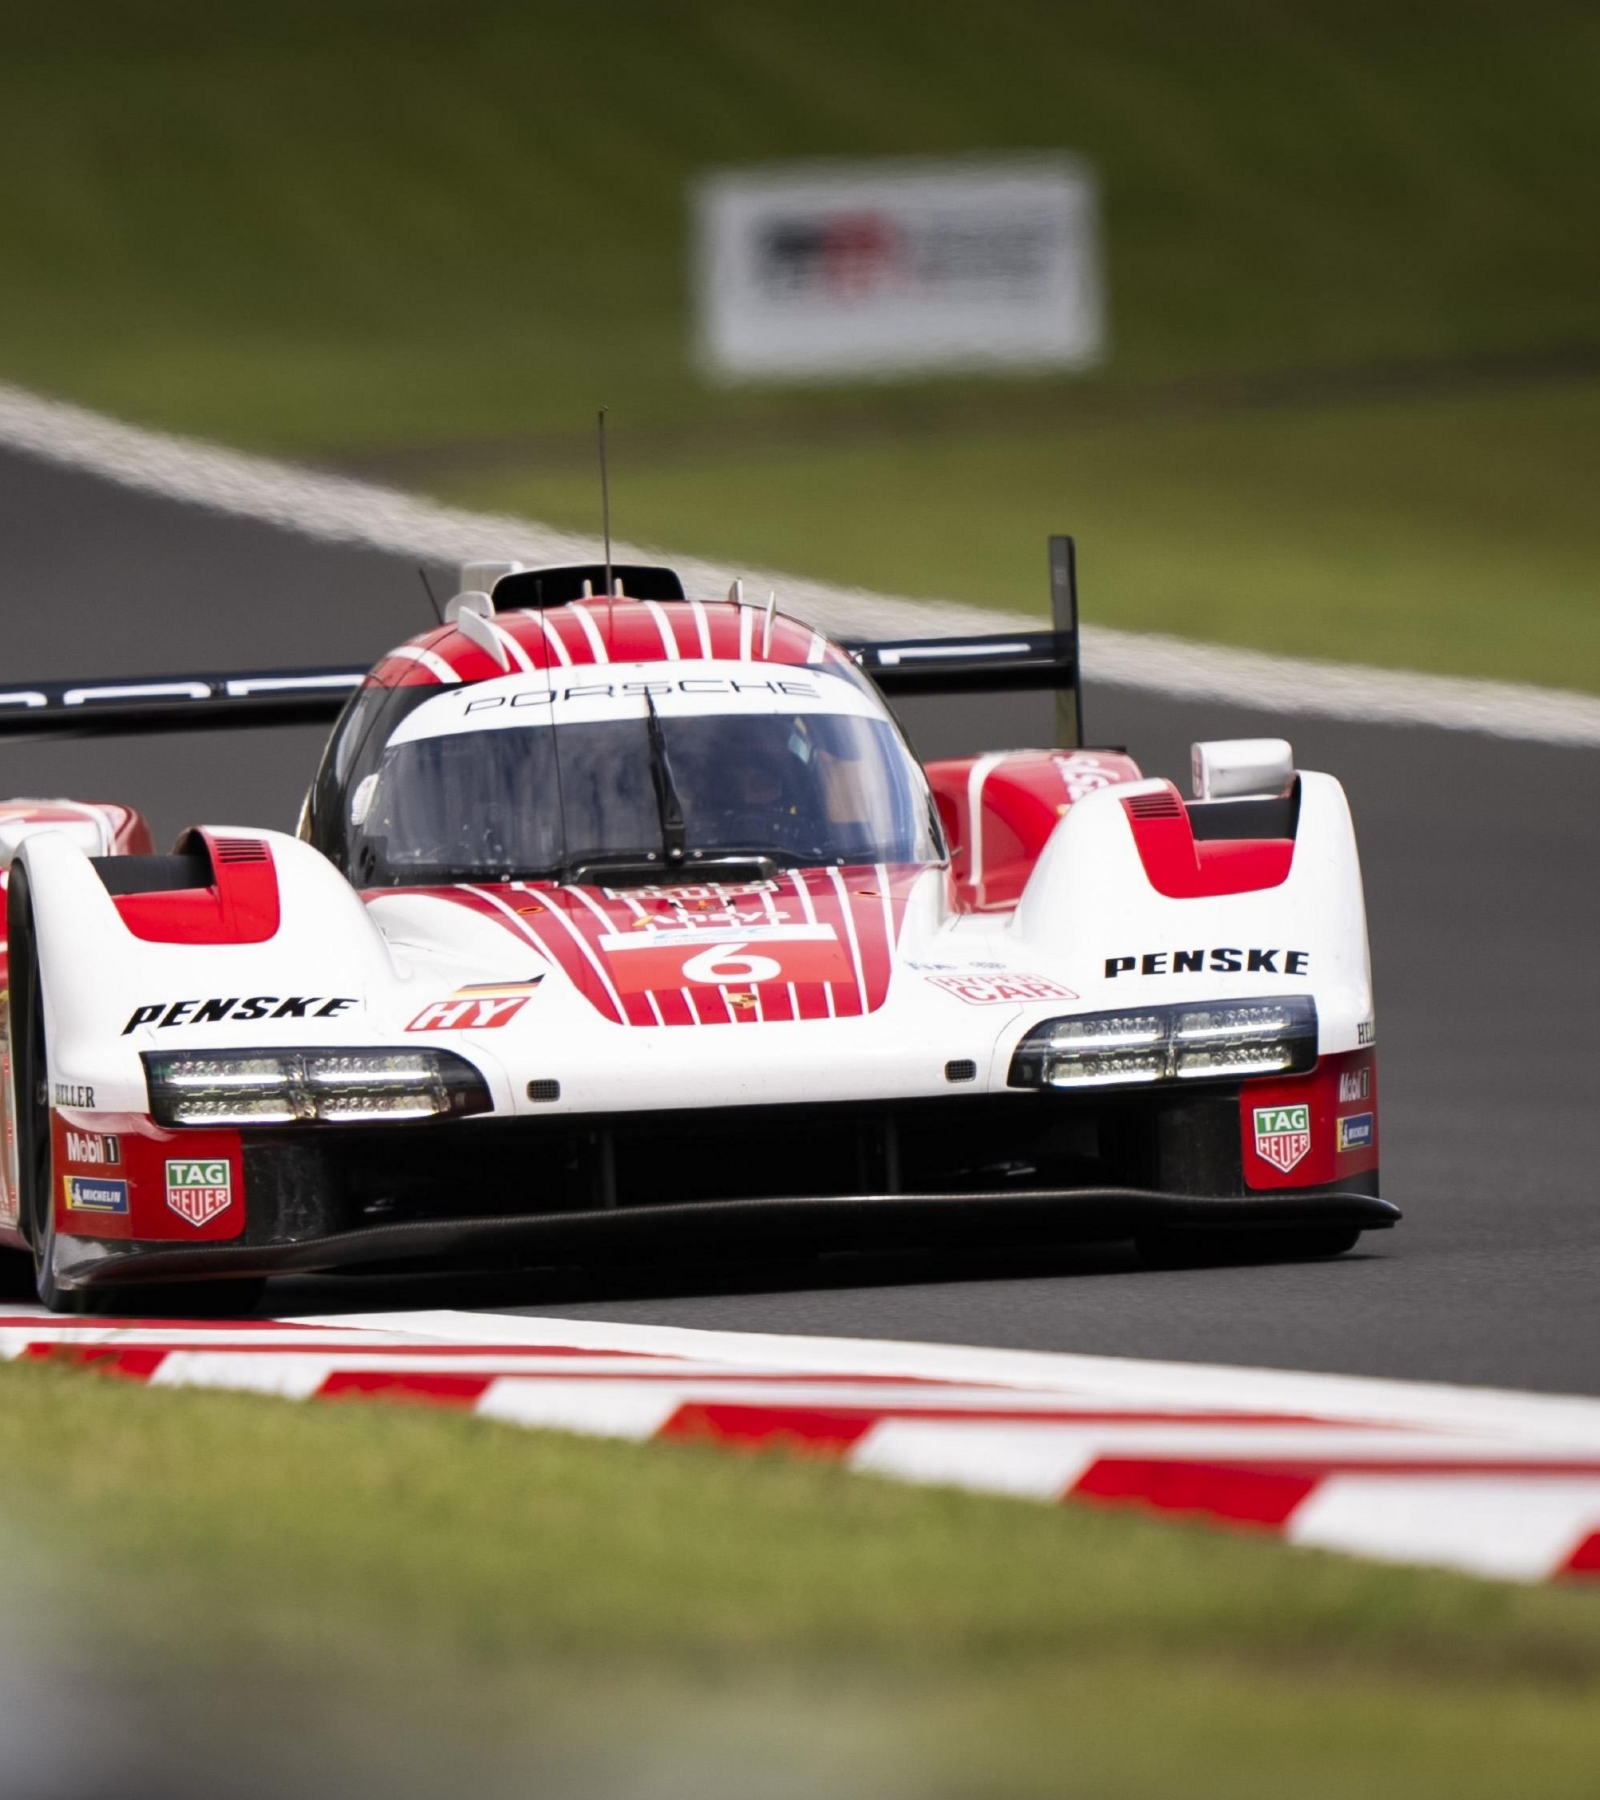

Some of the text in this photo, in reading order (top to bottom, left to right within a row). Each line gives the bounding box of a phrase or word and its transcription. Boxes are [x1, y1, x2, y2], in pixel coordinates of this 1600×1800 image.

[463, 679, 823, 716] PORSCHE
[681, 942, 782, 985] 6
[1104, 947, 1310, 979] PENSKE
[936, 973, 1042, 988] HYPER
[956, 983, 1068, 1002] CAR
[120, 995, 360, 1036] PENSKE
[410, 999, 511, 1029] HY
[1259, 1109, 1305, 1132] TAG
[65, 1131, 116, 1163] Mobil 1
[1259, 1134, 1308, 1166] HEUER
[170, 1163, 225, 1185] TAG
[81, 1188, 122, 1204] MICHELIN
[170, 1187, 228, 1216] HEUER
